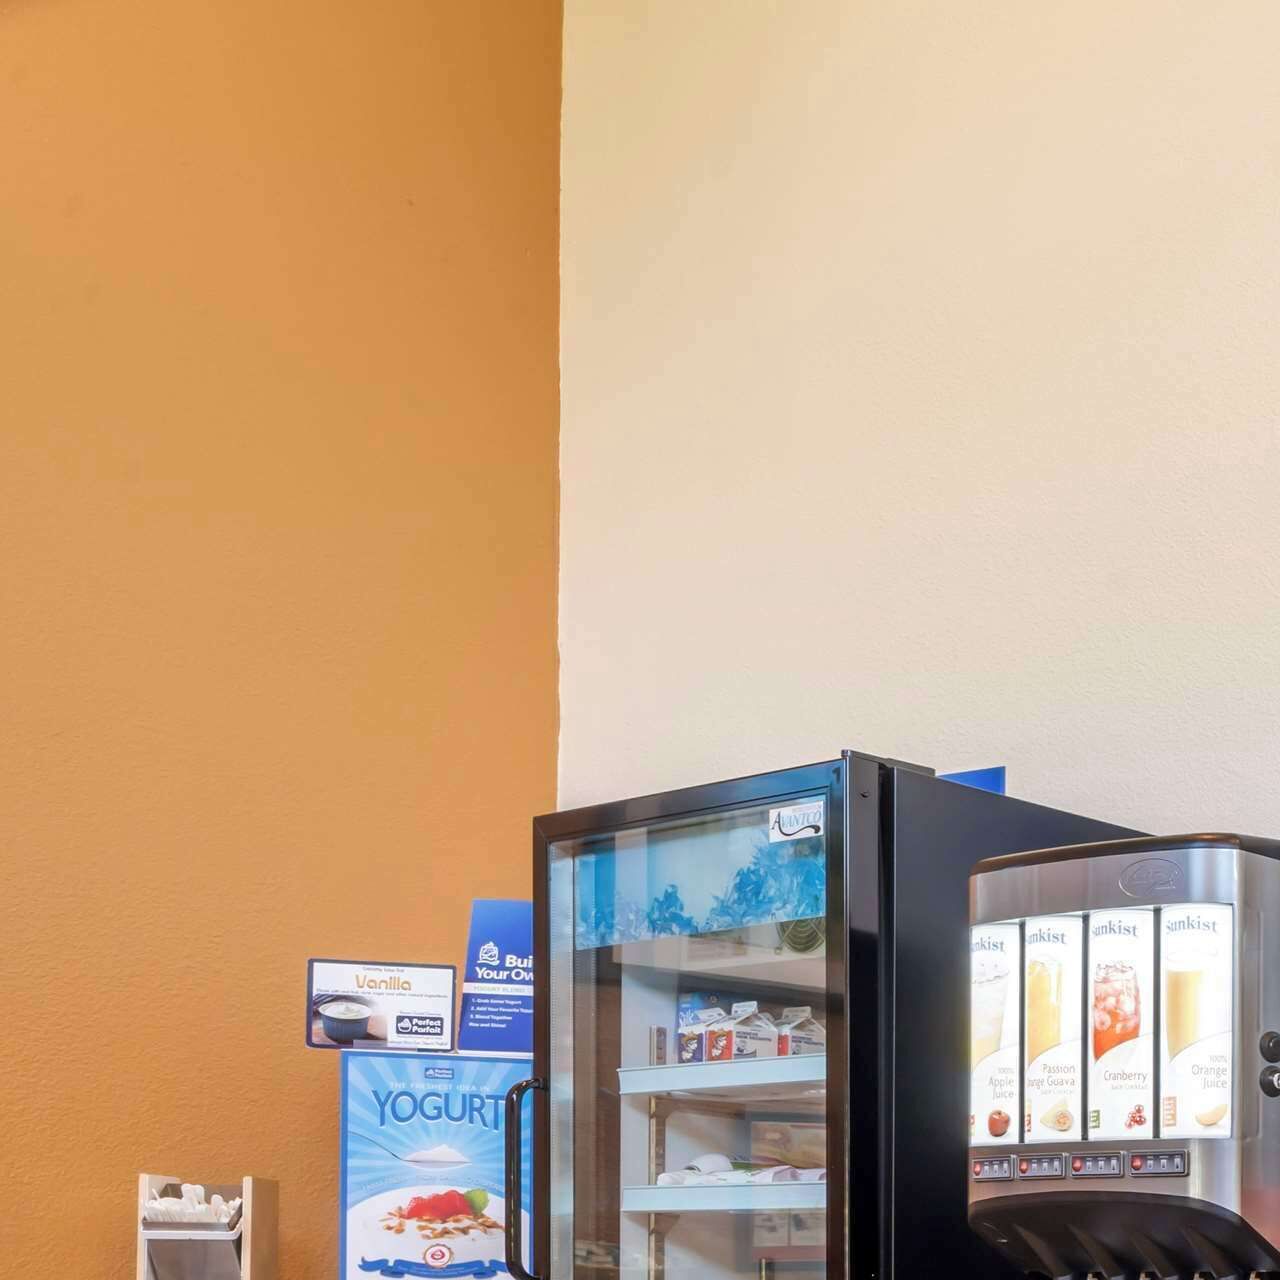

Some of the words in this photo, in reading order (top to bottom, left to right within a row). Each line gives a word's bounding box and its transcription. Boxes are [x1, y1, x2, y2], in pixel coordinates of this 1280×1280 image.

[505, 954, 533, 968] Bui
[475, 967, 509, 980] Your
[511, 968, 533, 981] Ow
[355, 974, 412, 991] Vanilla
[412, 1018, 442, 1026] Perfect
[412, 1026, 442, 1034] Parfait
[1042, 1064, 1076, 1074] Passion
[1191, 1064, 1228, 1079] Orange
[988, 1076, 1015, 1090] Apple
[1047, 1075, 1076, 1087] Guava
[1103, 1070, 1148, 1084] Cranberry
[1203, 1079, 1228, 1089] Juice
[993, 1087, 1015, 1101] Juice
[371, 1090, 506, 1131] YOGURT
